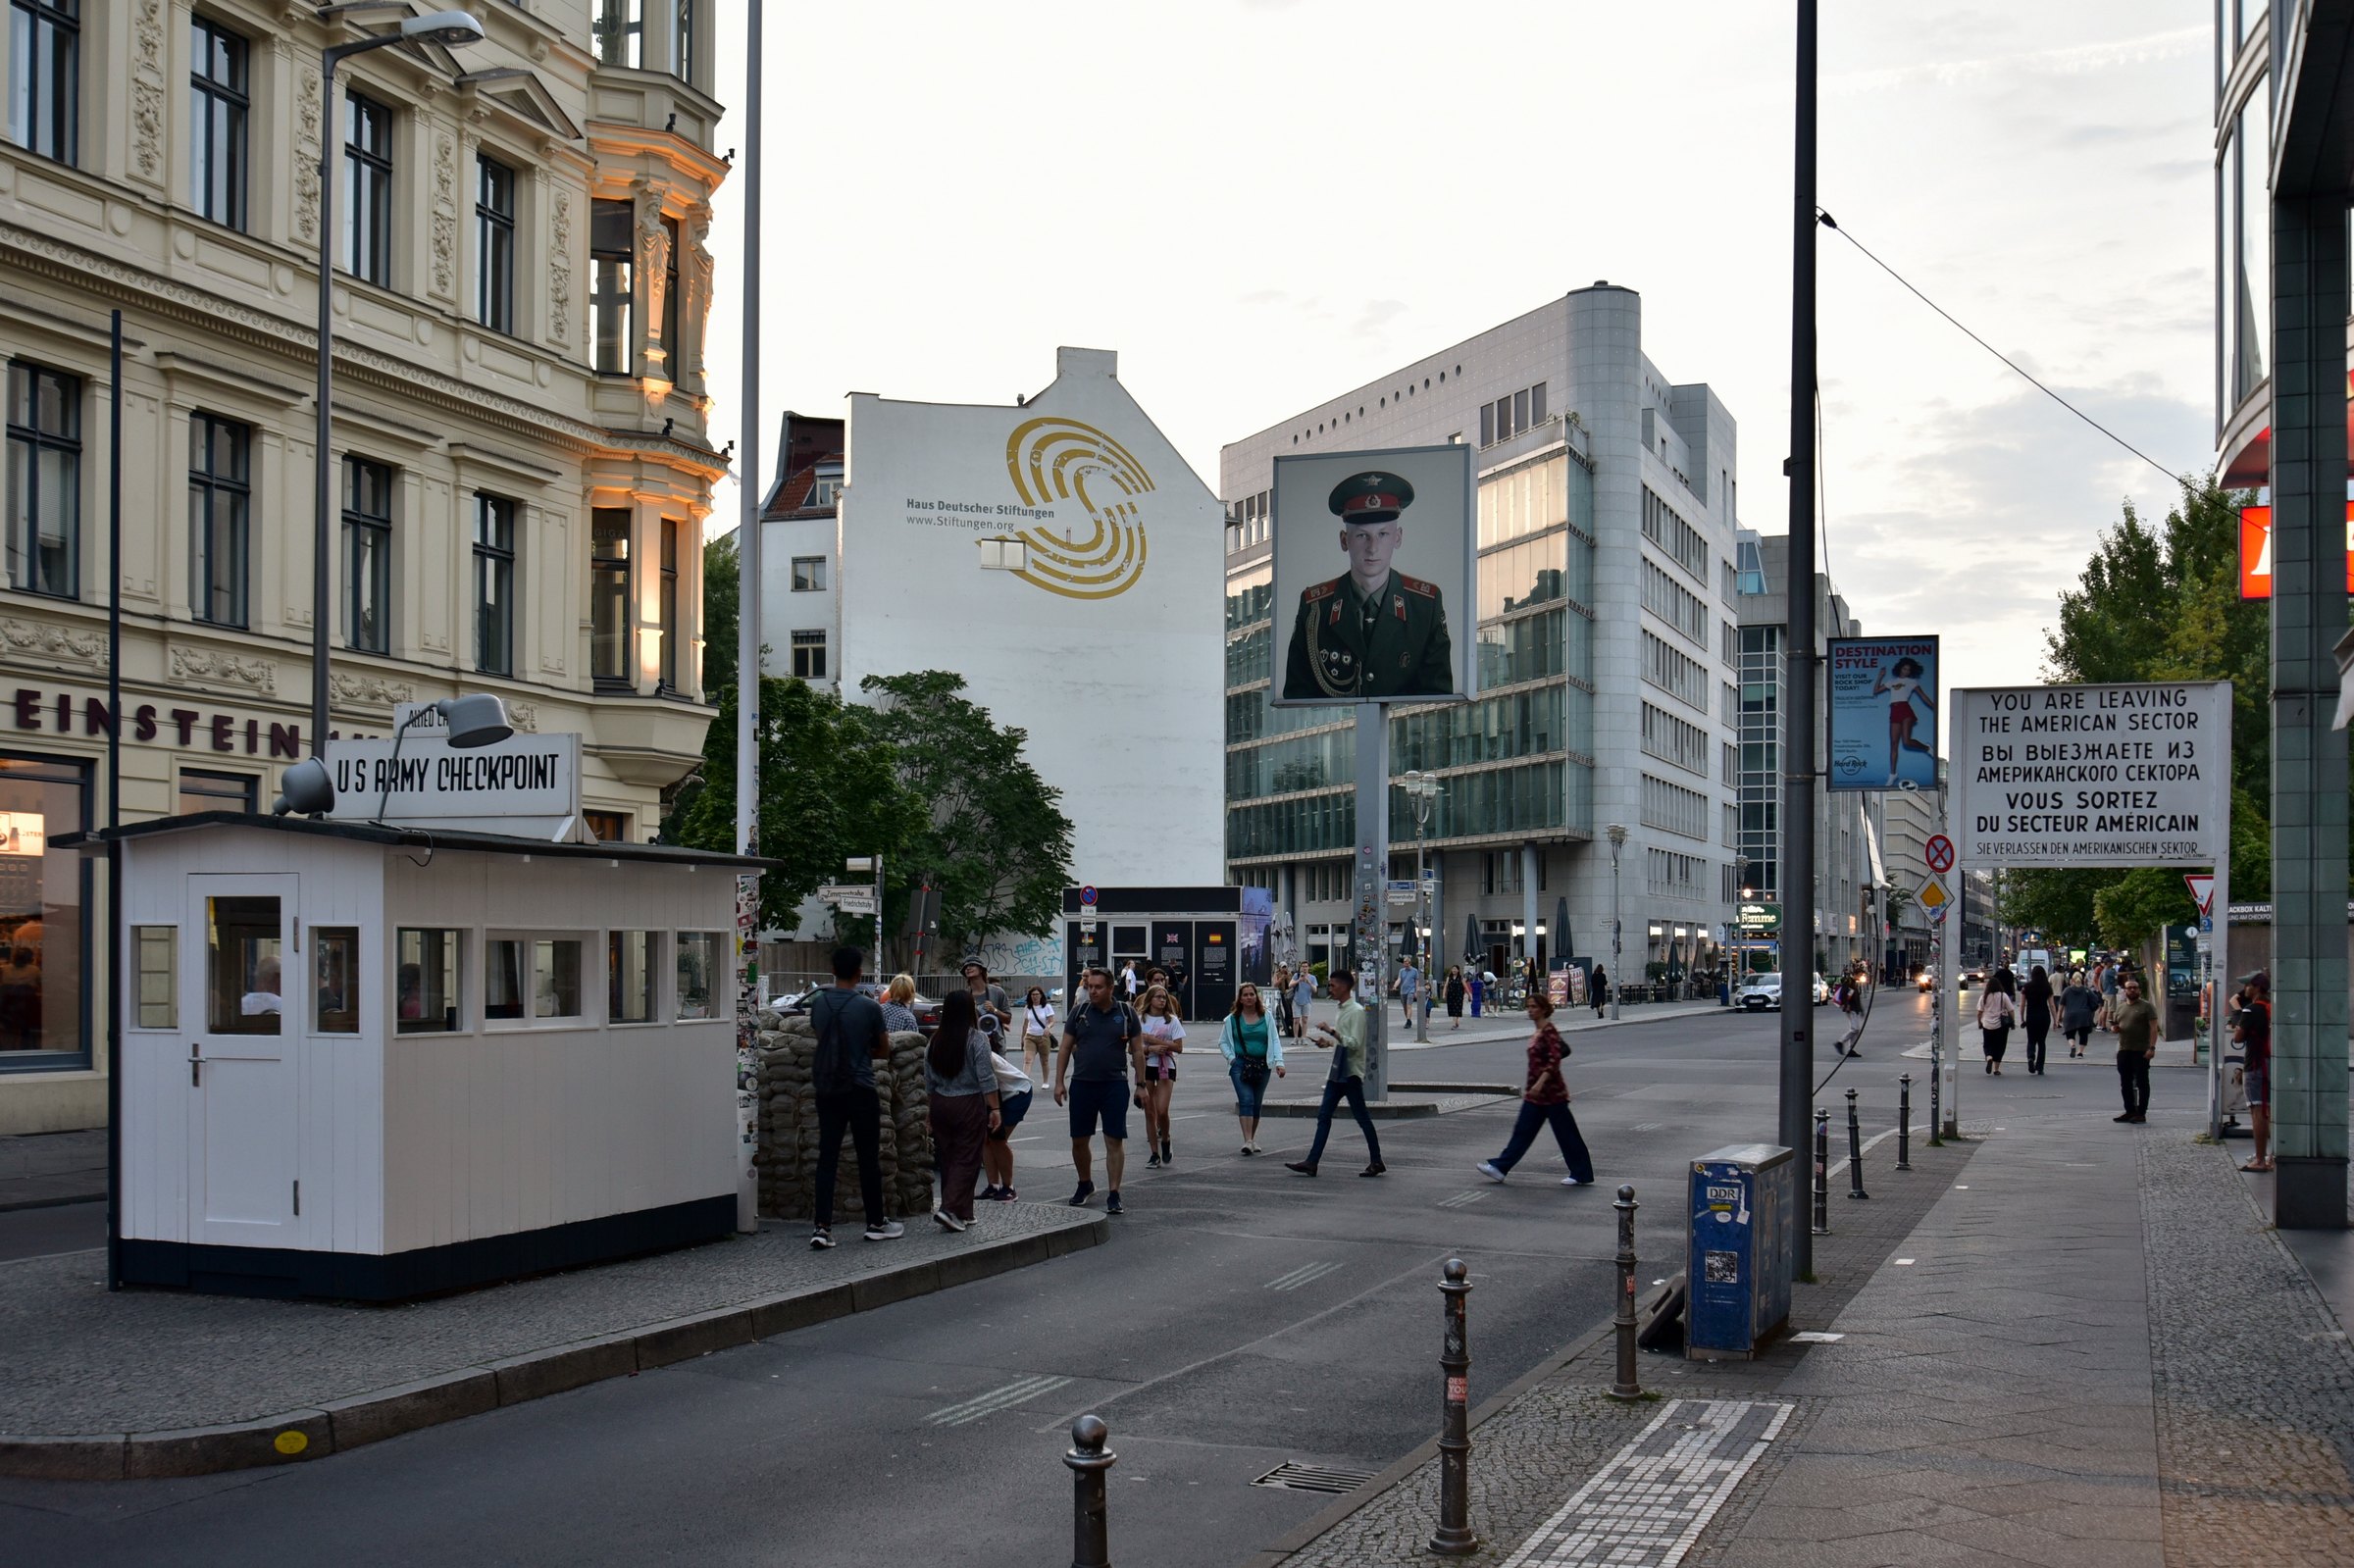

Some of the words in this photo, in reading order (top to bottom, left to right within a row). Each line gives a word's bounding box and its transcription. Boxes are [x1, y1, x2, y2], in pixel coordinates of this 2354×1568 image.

[906, 498, 935, 510] Haus
[938, 500, 994, 515] Deutscher
[997, 504, 1054, 520] Stiftungen
[906, 516, 1014, 532] www.Stiftungen.org
[1835, 644, 1932, 657] DESTINATION
[1835, 658, 1878, 669] STYLE
[1990, 693, 2031, 711] YOU
[2044, 692, 2084, 710] ARE
[2099, 689, 2187, 709] LEAVING
[16, 688, 299, 759] EINSTEIN
[409, 709, 435, 729] ALLIED
[1979, 716, 2011, 733] THE
[2021, 714, 2117, 733] AMERICAN
[2128, 712, 2199, 731] SECTOR
[1982, 744, 2013, 762] ВЫ
[2026, 742, 2153, 762] ВЫЕЗЖАЕТЕ
[2168, 740, 2195, 760] ИЗ
[337, 759, 349, 793] U
[355, 759, 367, 793] S
[375, 758, 430, 793] ARMY
[437, 753, 559, 792] CHECKPOINT
[1976, 765, 2118, 784] АМЕРИКАНСКОГО
[2125, 764, 2200, 782] СЕКТОРА
[2006, 791, 2064, 810] VOUS
[2075, 790, 2158, 810] SORTEZ
[1976, 815, 2000, 833] DU
[2007, 815, 2088, 833] SECTEUR
[2095, 811, 2199, 833] AMÉRICAIN
[1976, 842, 1991, 855] SIE
[1993, 841, 2048, 855] VERLASSEN
[2050, 841, 2069, 855] DEN
[2073, 841, 2157, 855] AMERIKANISCHEN
[2161, 841, 2198, 854] SEKTOR
[1710, 1188, 1736, 1198] DDR
